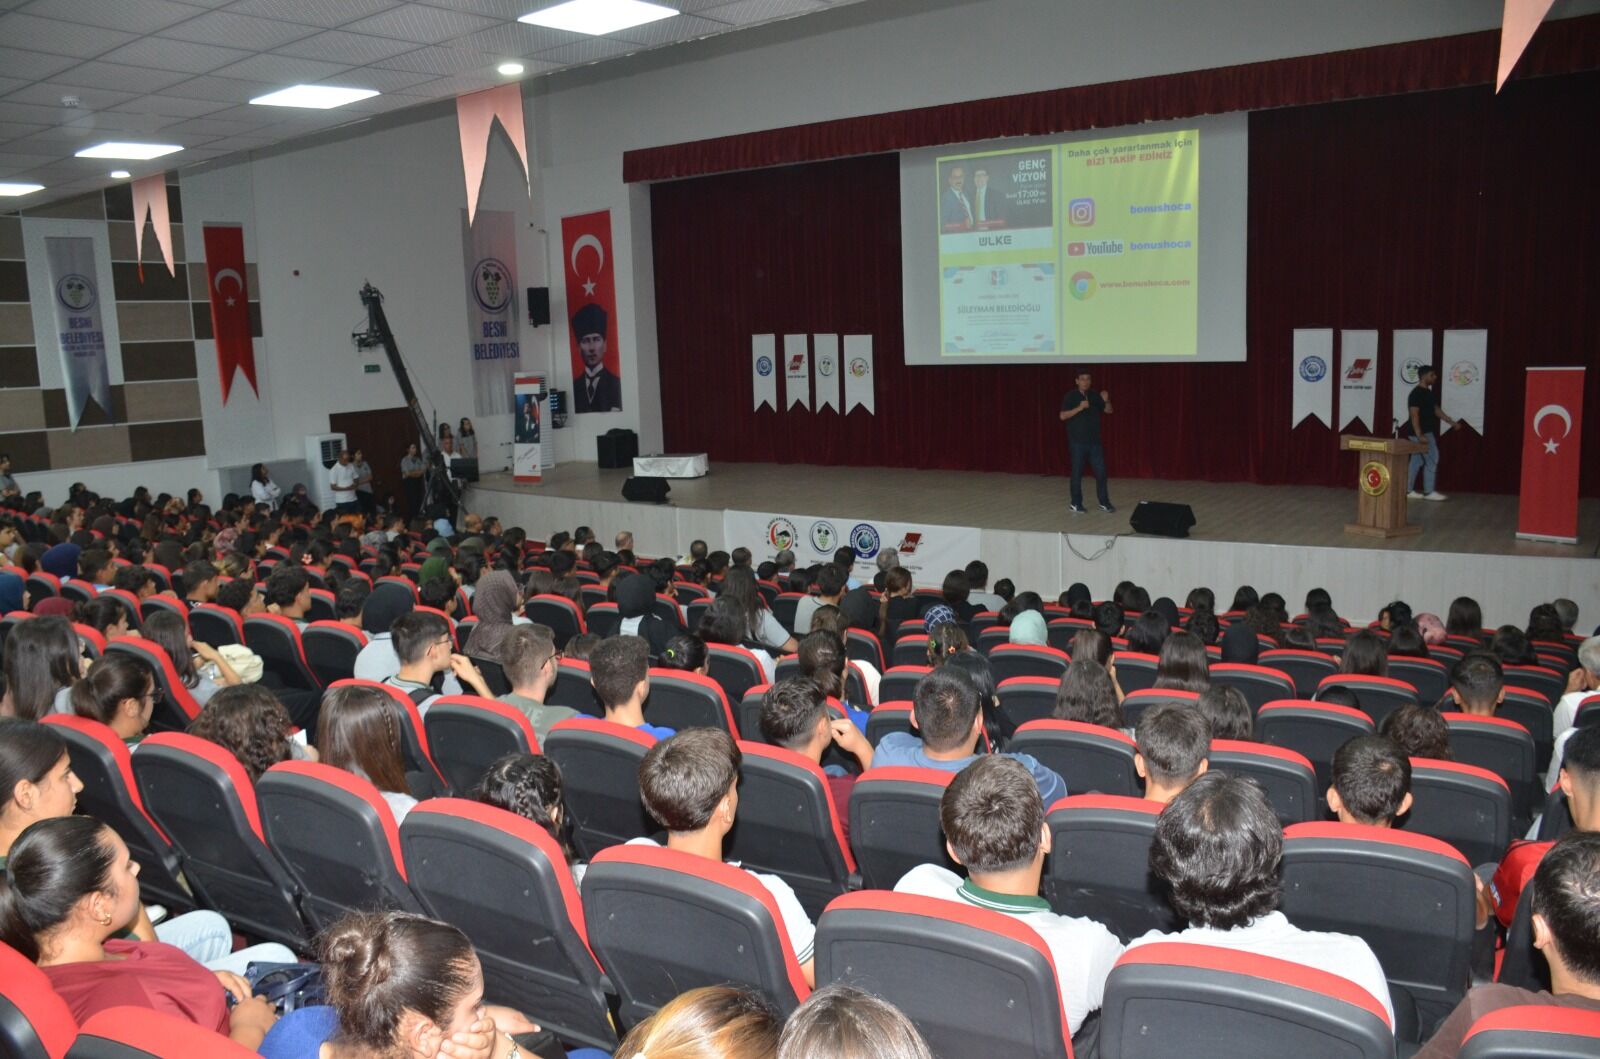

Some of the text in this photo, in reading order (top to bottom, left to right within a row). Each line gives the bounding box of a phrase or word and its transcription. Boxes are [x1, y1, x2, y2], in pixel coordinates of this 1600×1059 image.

[1068, 150, 1091, 158] Daha
[1094, 146, 1110, 156] çok
[1018, 158, 1046, 171] GENÇ
[1012, 171, 1047, 183] VİZYON
[1130, 202, 1192, 214] bonushoca
[1086, 241, 1123, 255] YouTube
[1130, 240, 1192, 251] bonushoca
[474, 341, 520, 361] BELEDİYESİ
